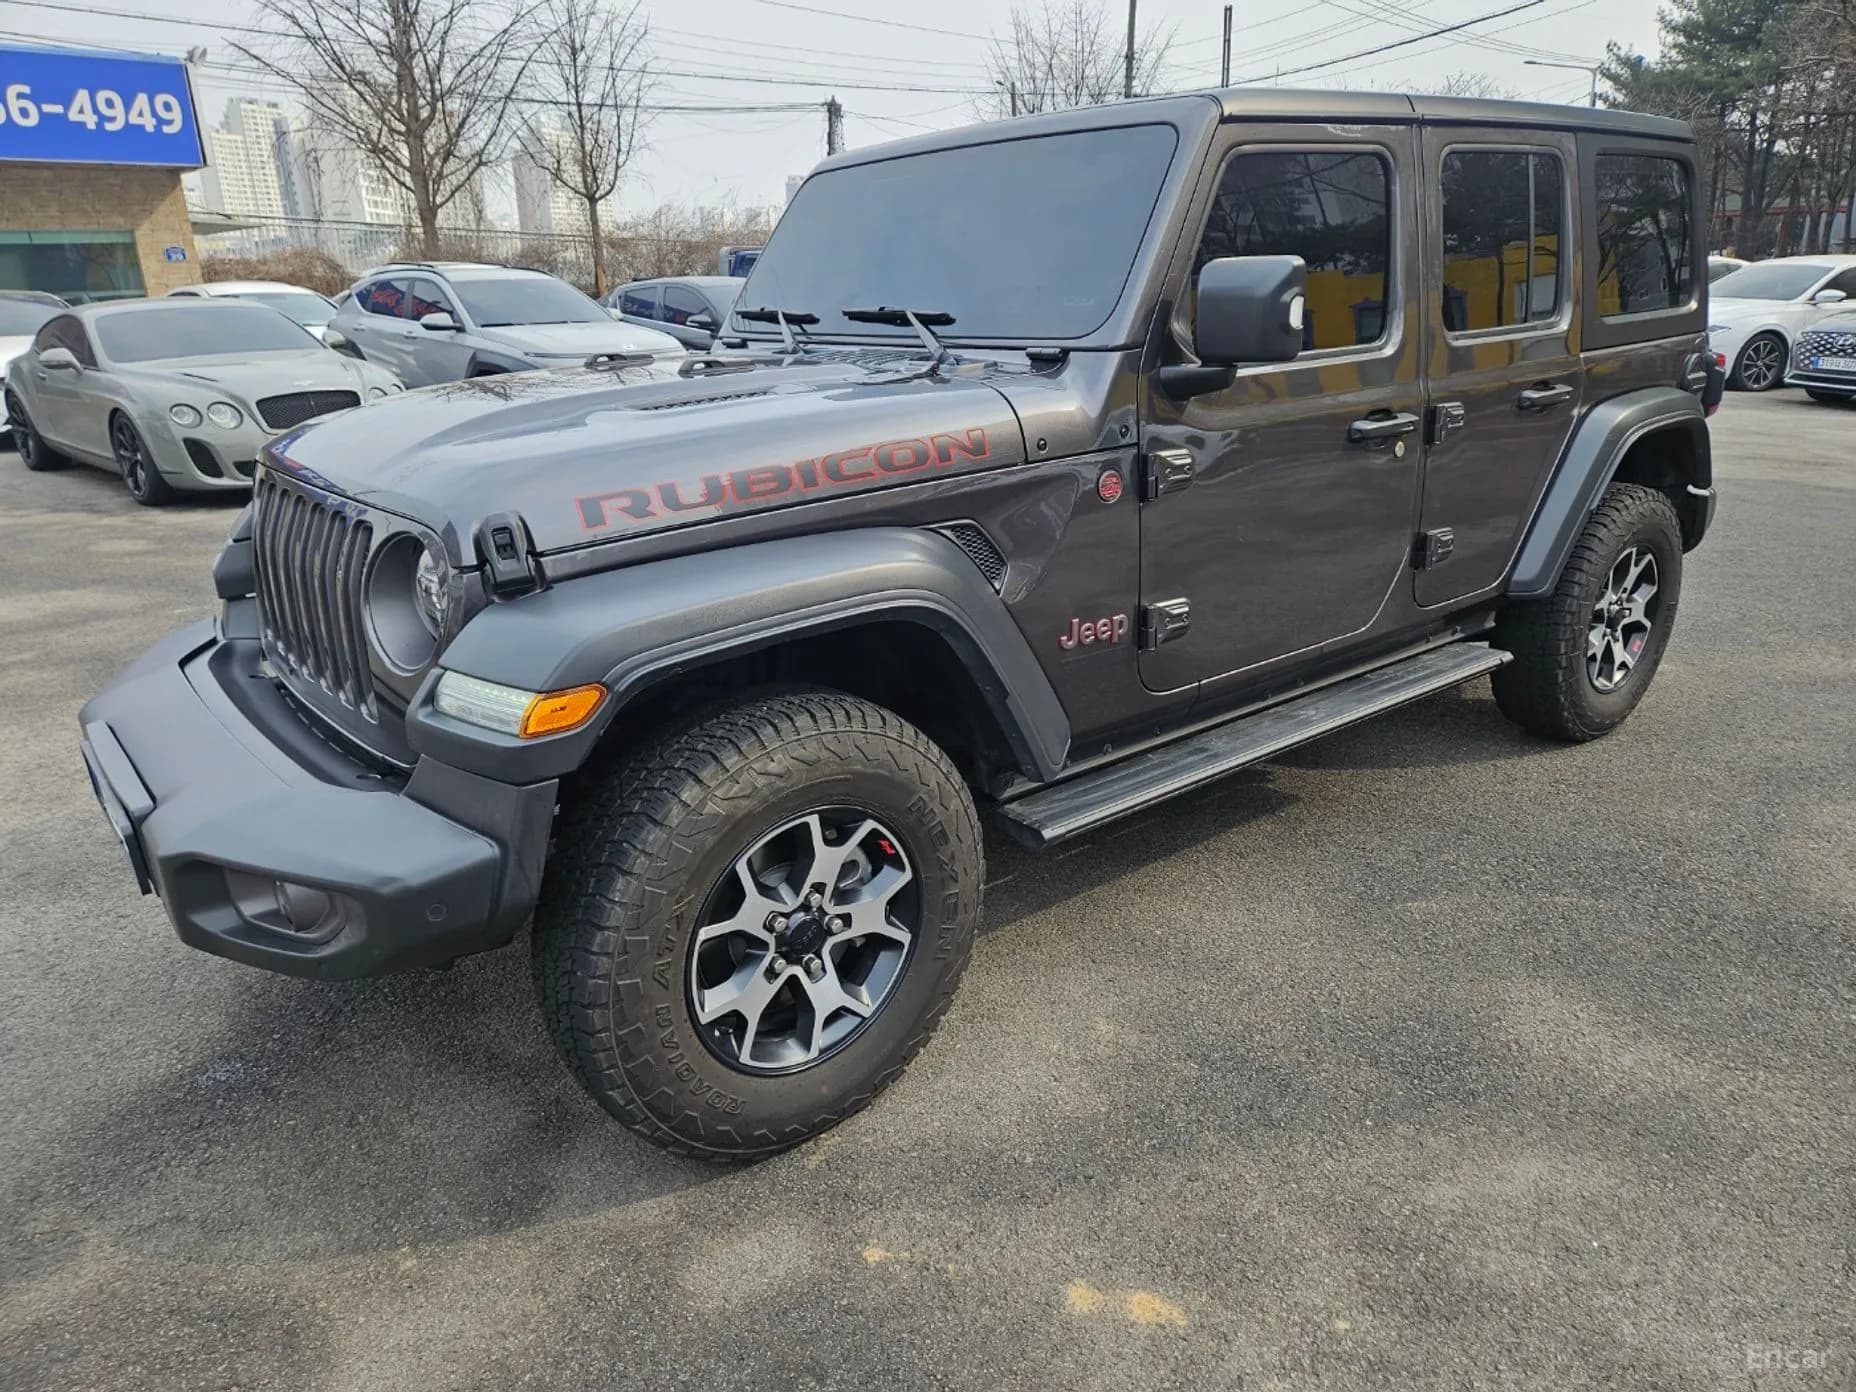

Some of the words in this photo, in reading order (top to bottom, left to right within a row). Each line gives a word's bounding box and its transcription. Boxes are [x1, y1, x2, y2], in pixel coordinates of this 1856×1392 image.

[0, 84, 184, 134] 6-4949
[575, 428, 990, 530] RUBICON
[1059, 613, 1129, 651] Jeep
[906, 795, 960, 961] NEXEN
[655, 1003, 747, 1115] ROADIAN
